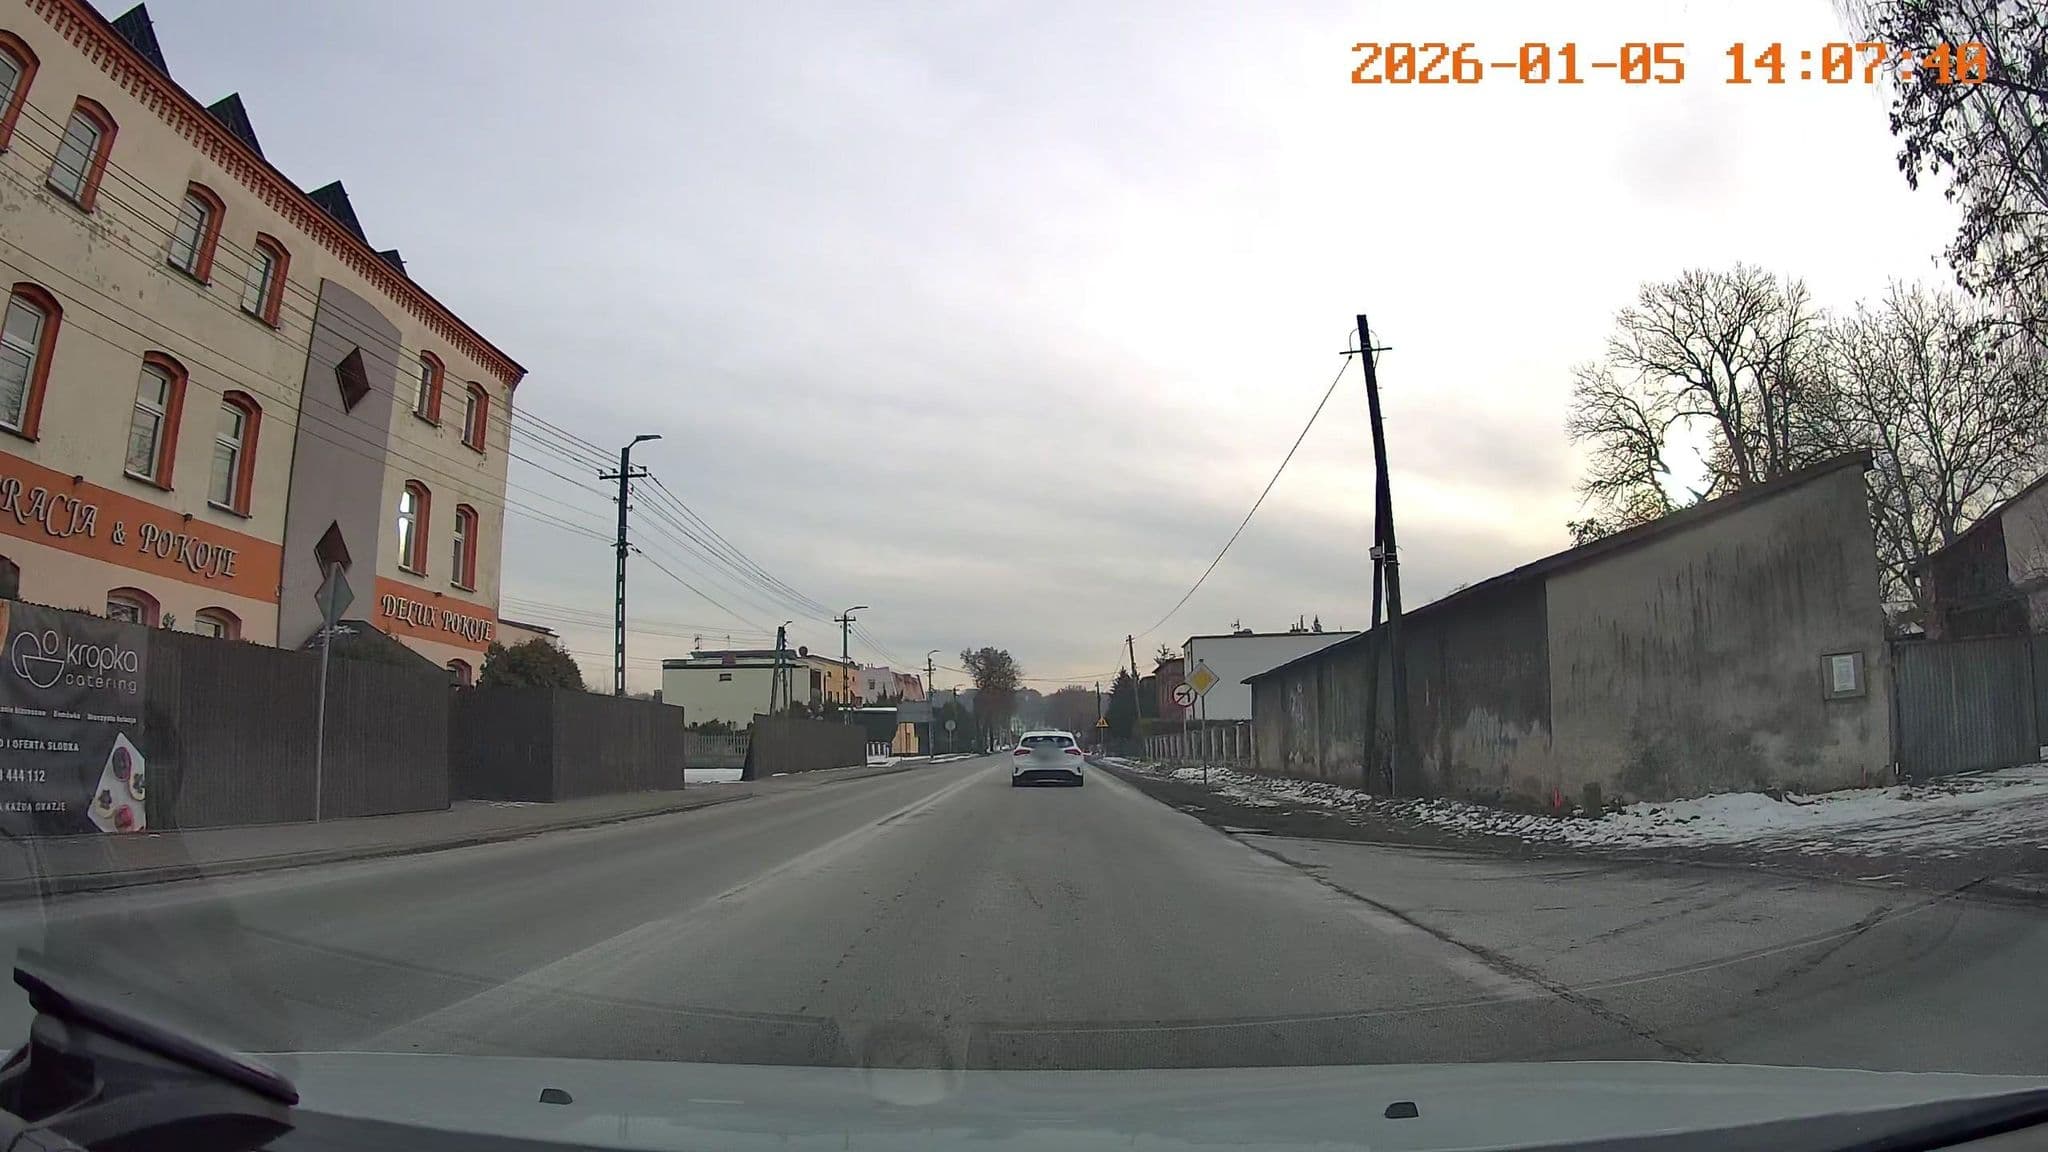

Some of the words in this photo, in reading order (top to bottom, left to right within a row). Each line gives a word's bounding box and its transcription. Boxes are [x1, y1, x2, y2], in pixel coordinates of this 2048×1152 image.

[0, 475, 98, 538] RACJA
[112, 521, 126, 546] &
[139, 523, 239, 578] POKOJE
[382, 594, 438, 627] DELUX
[442, 610, 493, 643] POKOJE
[66, 637, 138, 675] kropka
[65, 673, 137, 694] catering
[12, 739, 45, 750] OFERTA
[6, 769, 25, 782] 444
[28, 769, 46, 783] 112
